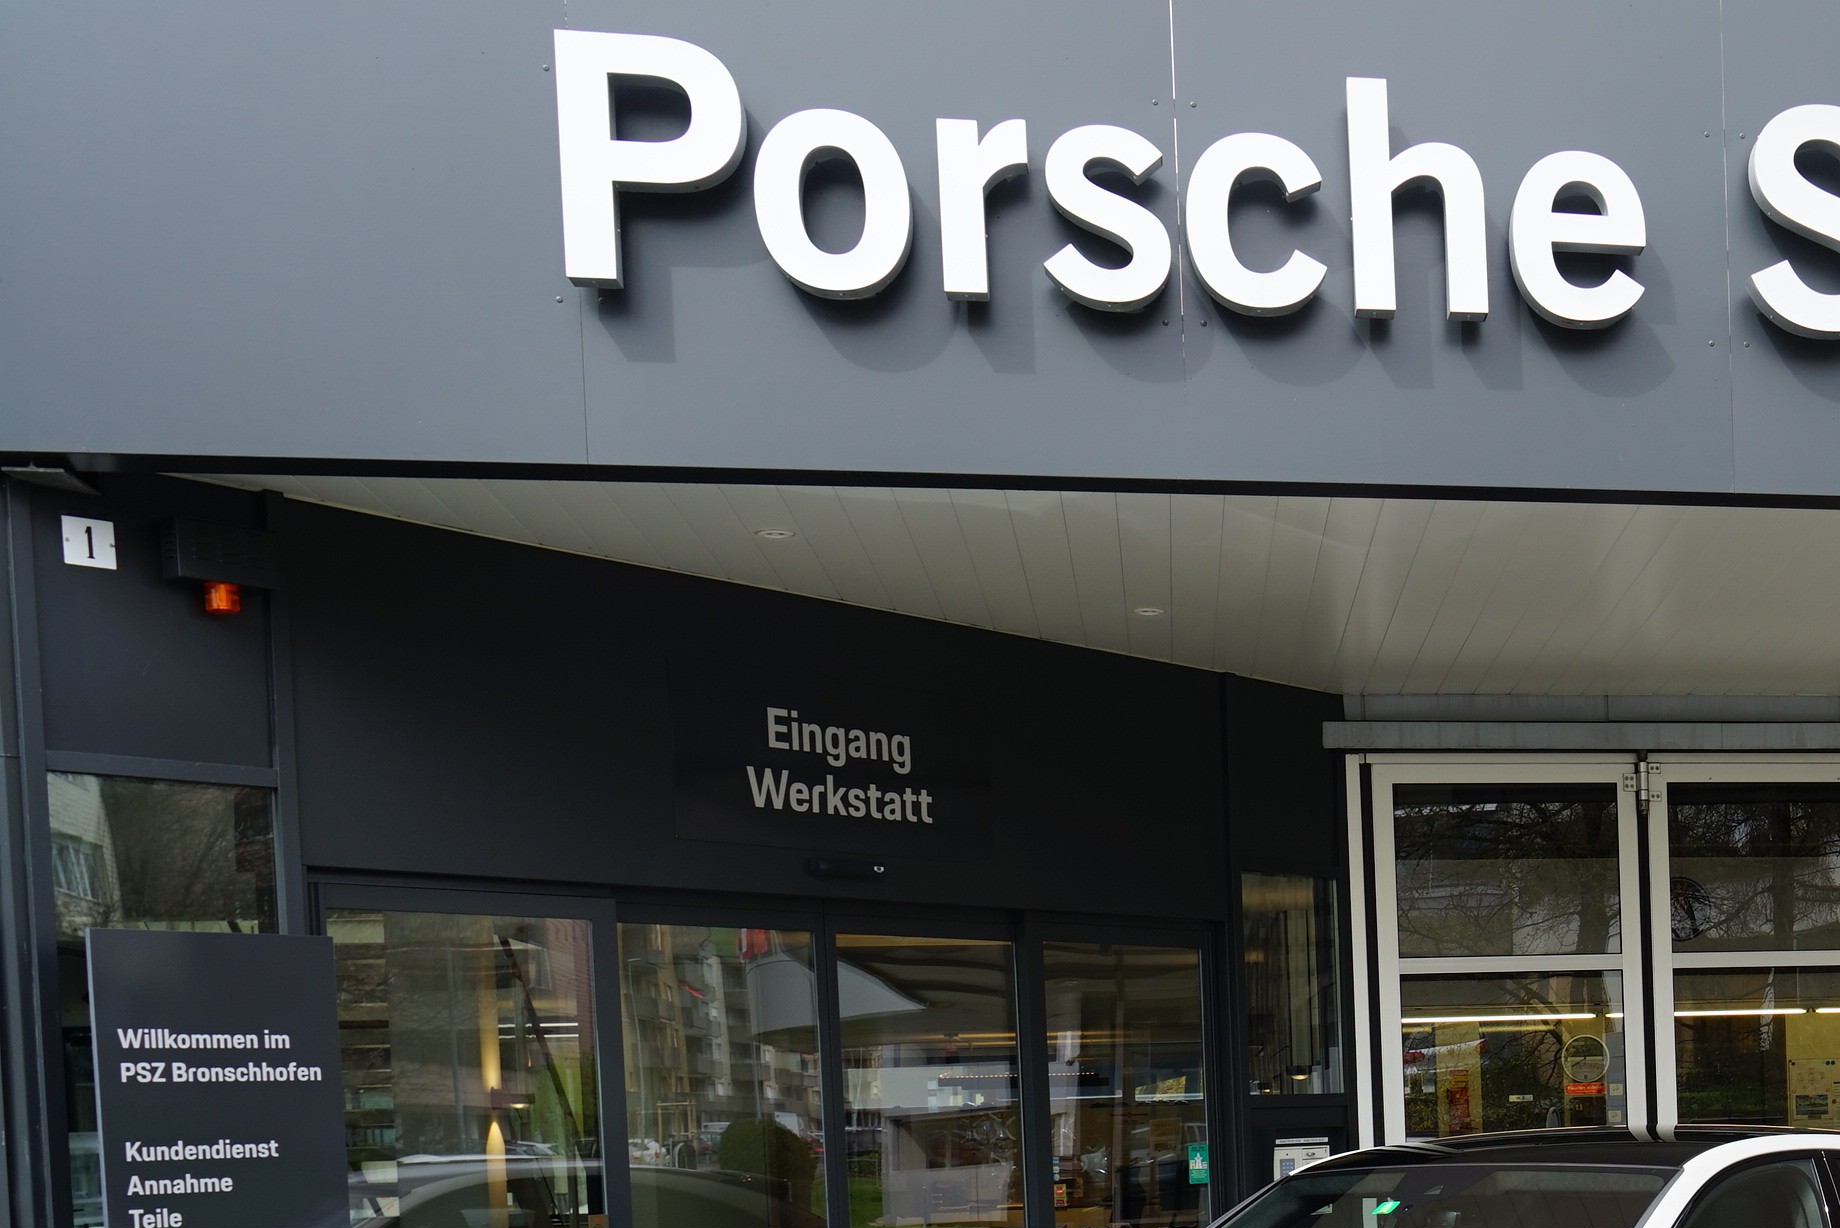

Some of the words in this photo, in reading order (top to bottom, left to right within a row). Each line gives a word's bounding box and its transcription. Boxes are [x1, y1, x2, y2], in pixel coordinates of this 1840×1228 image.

[552, 27, 1647, 332] Porsche
[85, 526, 96, 559] 1
[766, 706, 912, 775] Eingang
[746, 765, 933, 824] Werkstatt
[117, 1028, 259, 1050] Willkommen
[264, 1029, 290, 1049] im
[120, 1062, 166, 1084] PSZ
[172, 1062, 322, 1083] Bronschhofen
[124, 1139, 280, 1162] Kundendienst
[126, 1173, 234, 1196] Annahme
